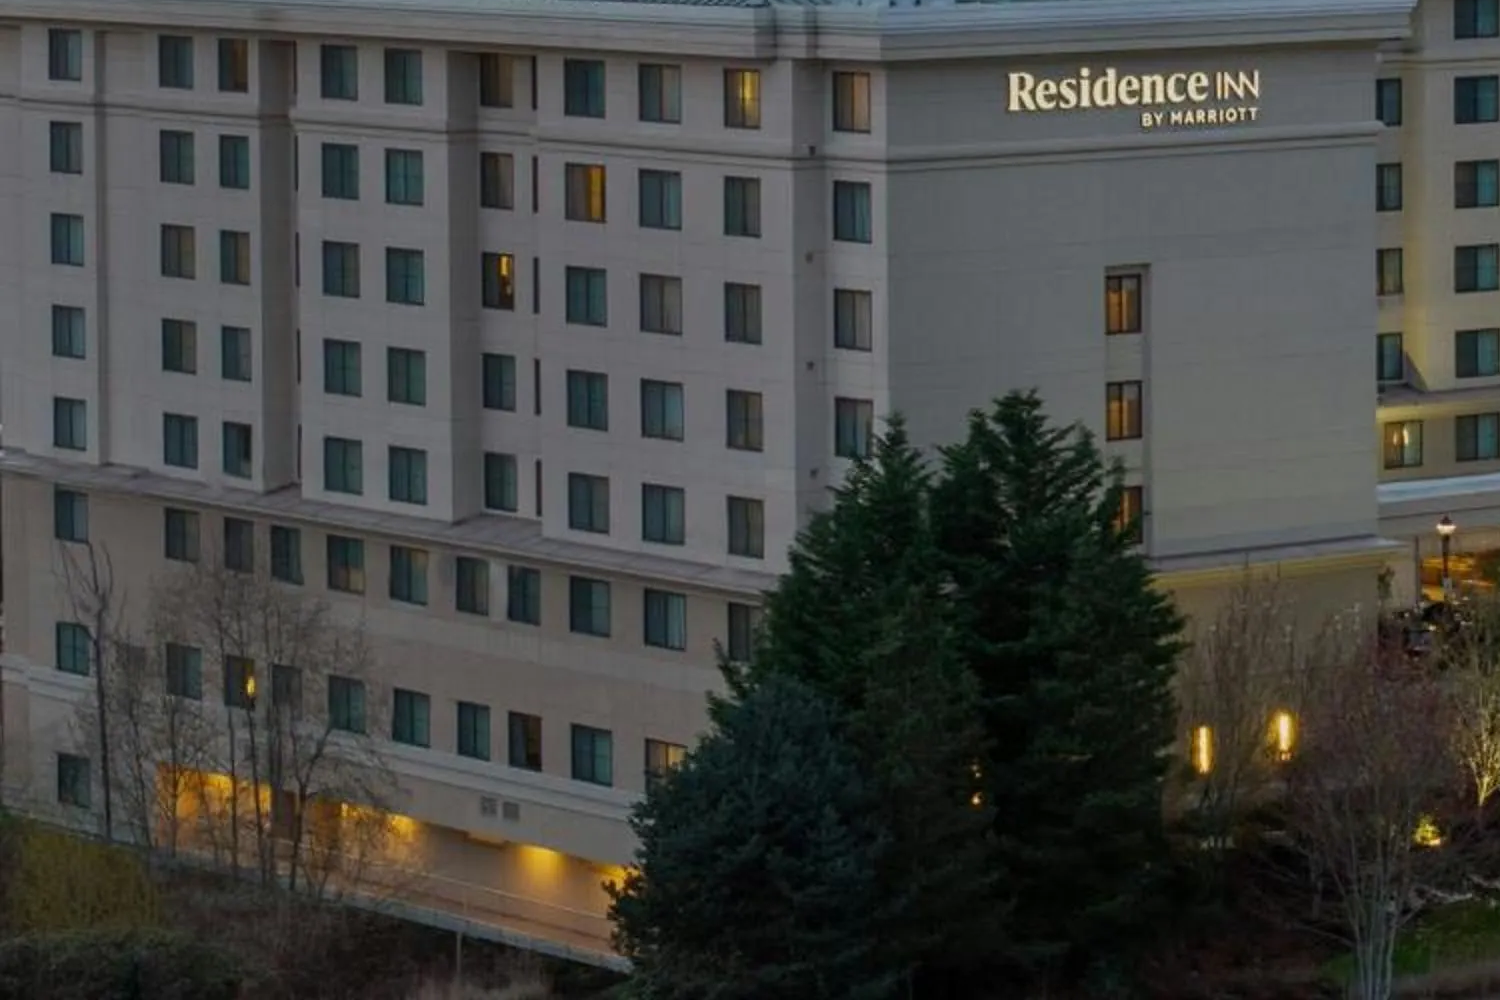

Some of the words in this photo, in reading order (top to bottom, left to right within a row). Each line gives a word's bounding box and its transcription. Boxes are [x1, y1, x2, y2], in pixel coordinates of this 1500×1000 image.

[1007, 67, 1209, 112] Residence
[1216, 70, 1260, 100] INN
[1142, 111, 1163, 127] BY
[1170, 107, 1258, 126] MARRIOTT
